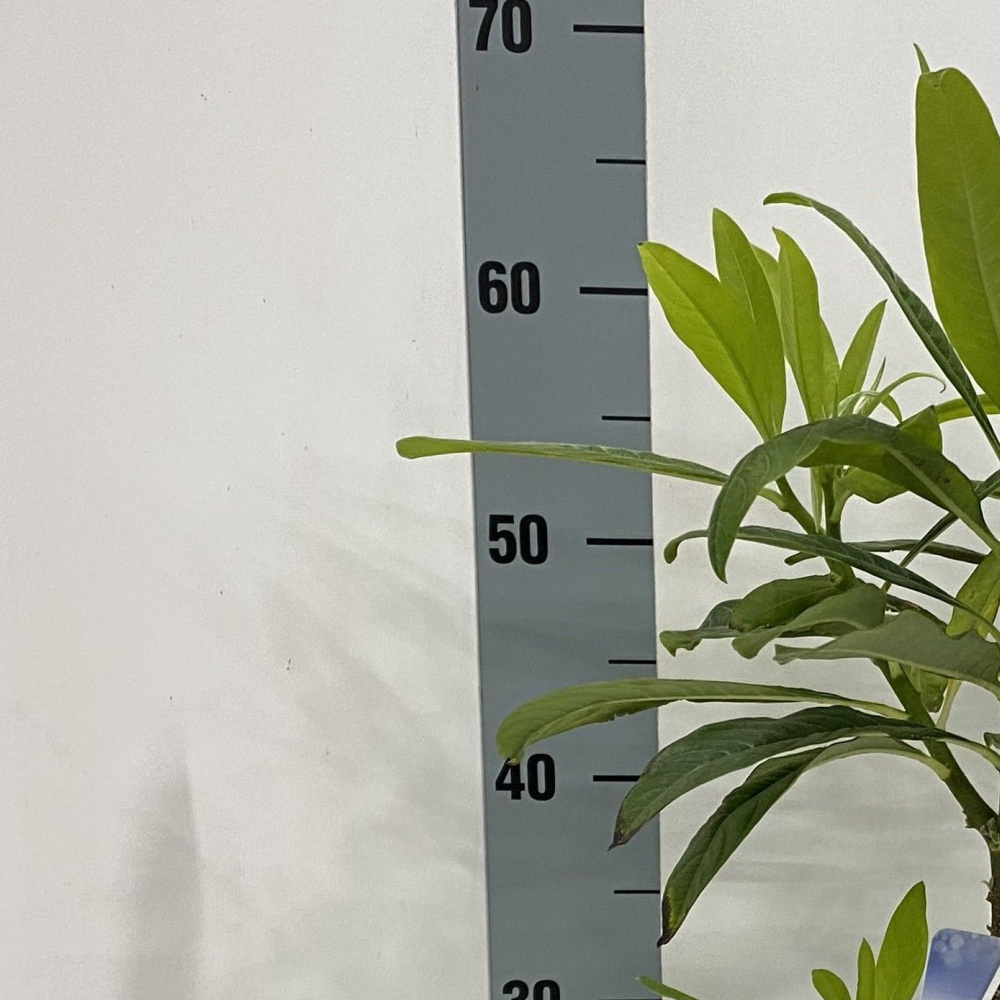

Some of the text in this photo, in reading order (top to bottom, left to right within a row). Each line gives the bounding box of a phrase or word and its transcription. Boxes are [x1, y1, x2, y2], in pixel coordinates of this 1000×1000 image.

[469, 0, 533, 53] 70
[478, 261, 541, 315] 60
[488, 513, 549, 565] 50
[495, 753, 556, 802] 40
